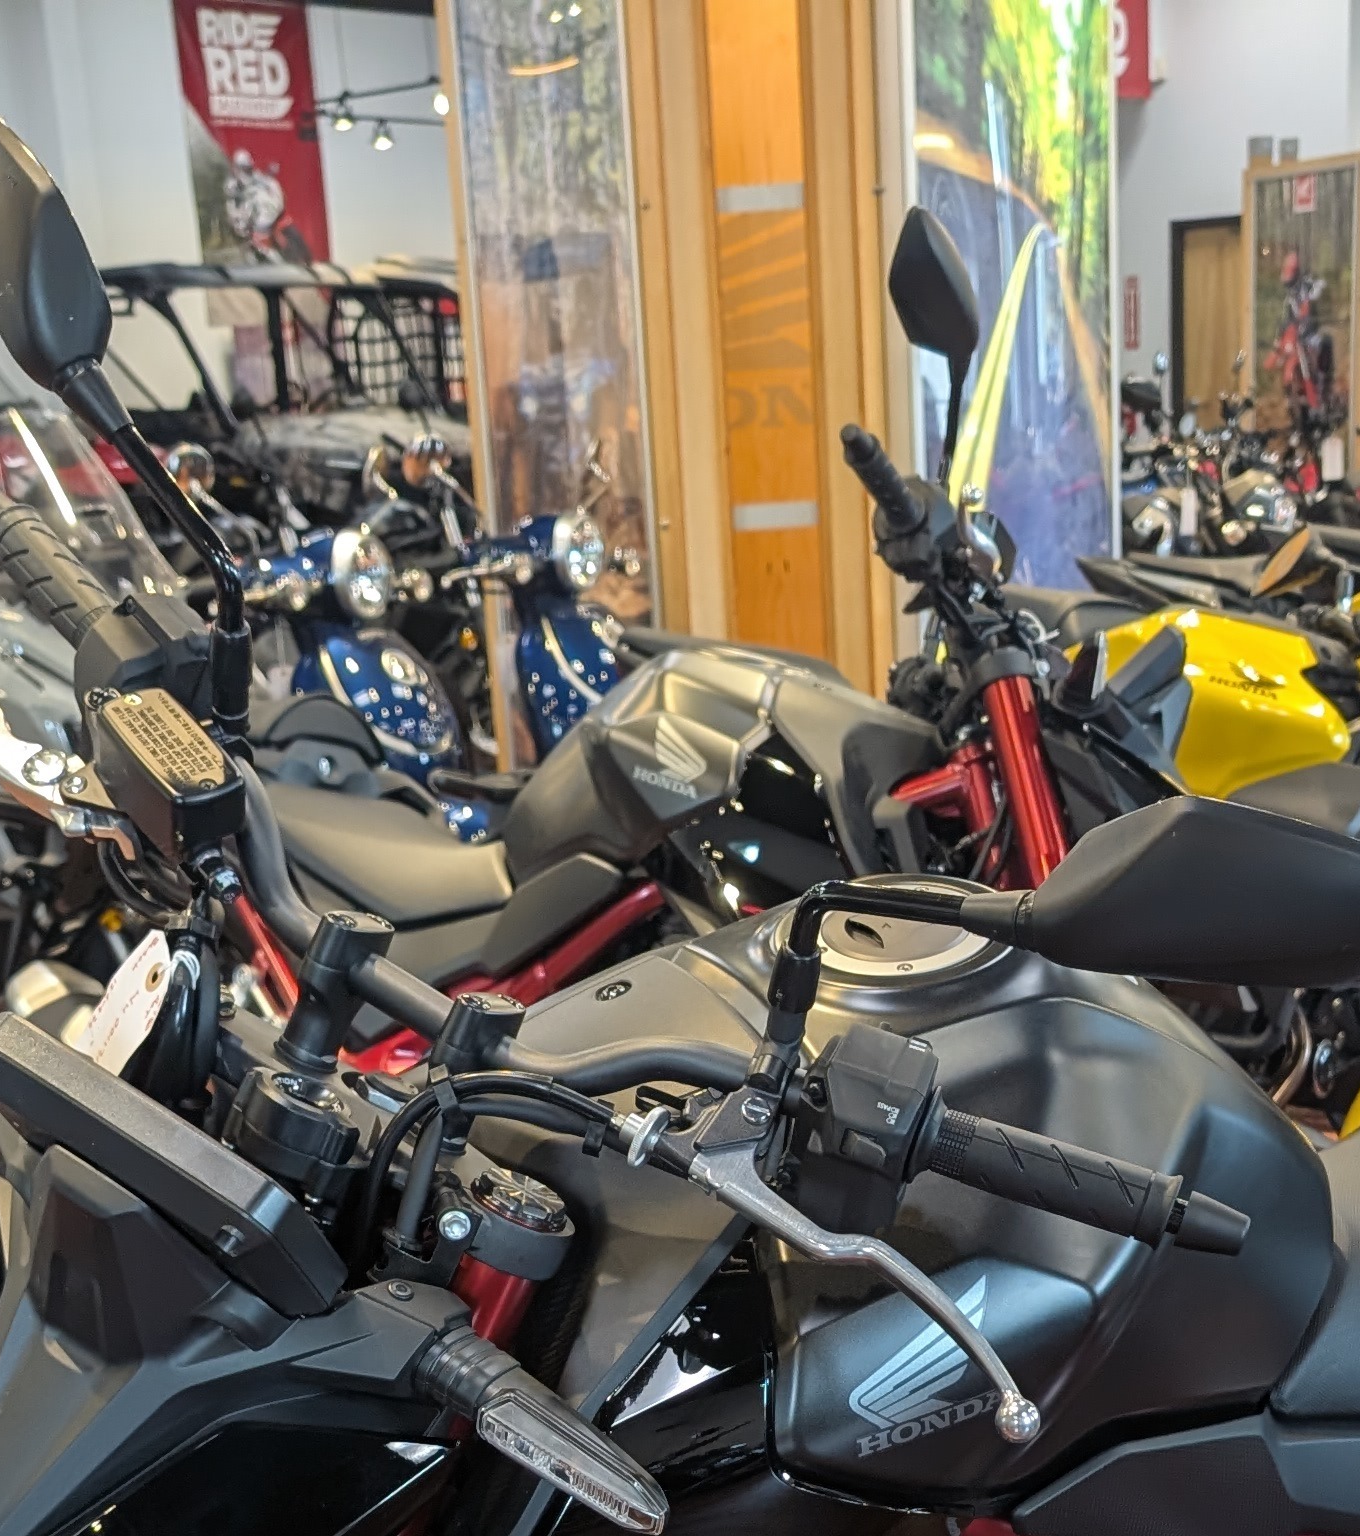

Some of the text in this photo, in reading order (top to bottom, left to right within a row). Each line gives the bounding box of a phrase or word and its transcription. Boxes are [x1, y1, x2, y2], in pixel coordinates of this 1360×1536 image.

[196, 8, 282, 49] RIDE
[202, 47, 291, 97] RED
[632, 765, 697, 799] HONDA
[877, 1101, 893, 1112] PASS
[856, 1389, 1002, 1458] HONDA
